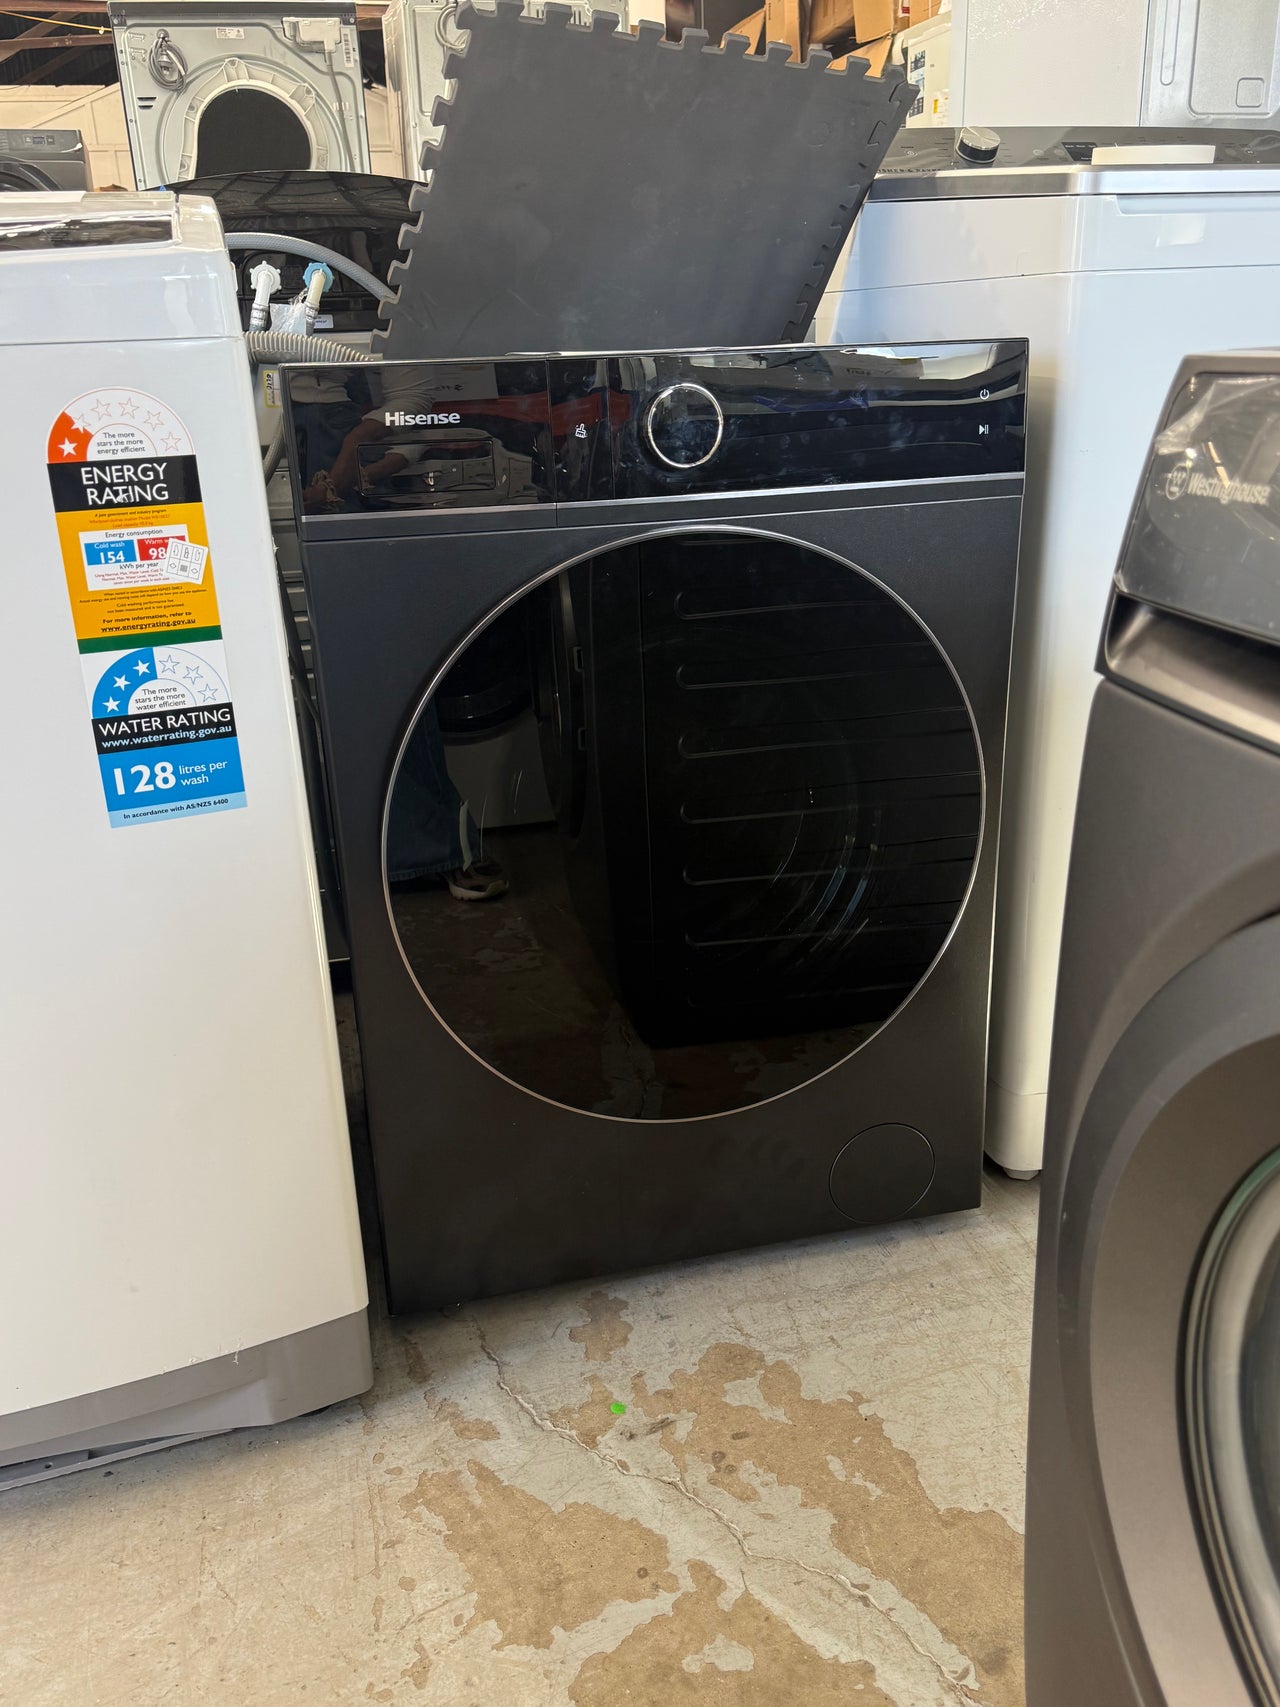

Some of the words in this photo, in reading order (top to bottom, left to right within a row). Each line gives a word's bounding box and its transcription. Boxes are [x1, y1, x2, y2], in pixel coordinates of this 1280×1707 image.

[385, 411, 461, 426] Hisense
[120, 446, 146, 454] efficient
[81, 462, 167, 485] ENERGY
[86, 483, 169, 506] RATING
[1187, 473, 1271, 505] Westinghouse
[105, 531, 125, 539] Energy
[126, 528, 163, 538] consumption
[99, 550, 125, 564] 154
[148, 547, 166, 560] 98
[131, 613, 169, 621] information,
[101, 618, 196, 633] www.energyrating.gov.au
[158, 686, 177, 694] more
[134, 696, 152, 704] stars
[153, 694, 165, 702] the
[166, 693, 186, 701] more
[136, 703, 157, 711] water
[158, 699, 186, 709] efficient
[98, 717, 163, 737] WATER
[166, 708, 231, 730] RATING
[101, 724, 232, 749] www.waterrating.gov.au
[113, 761, 176, 796] 128
[179, 764, 206, 775] litres
[209, 761, 228, 774] per
[180, 773, 209, 786] wash
[131, 807, 169, 819] accordance
[170, 805, 185, 813] with
[186, 800, 212, 810] AS/NZS
[213, 798, 229, 806] 6400
